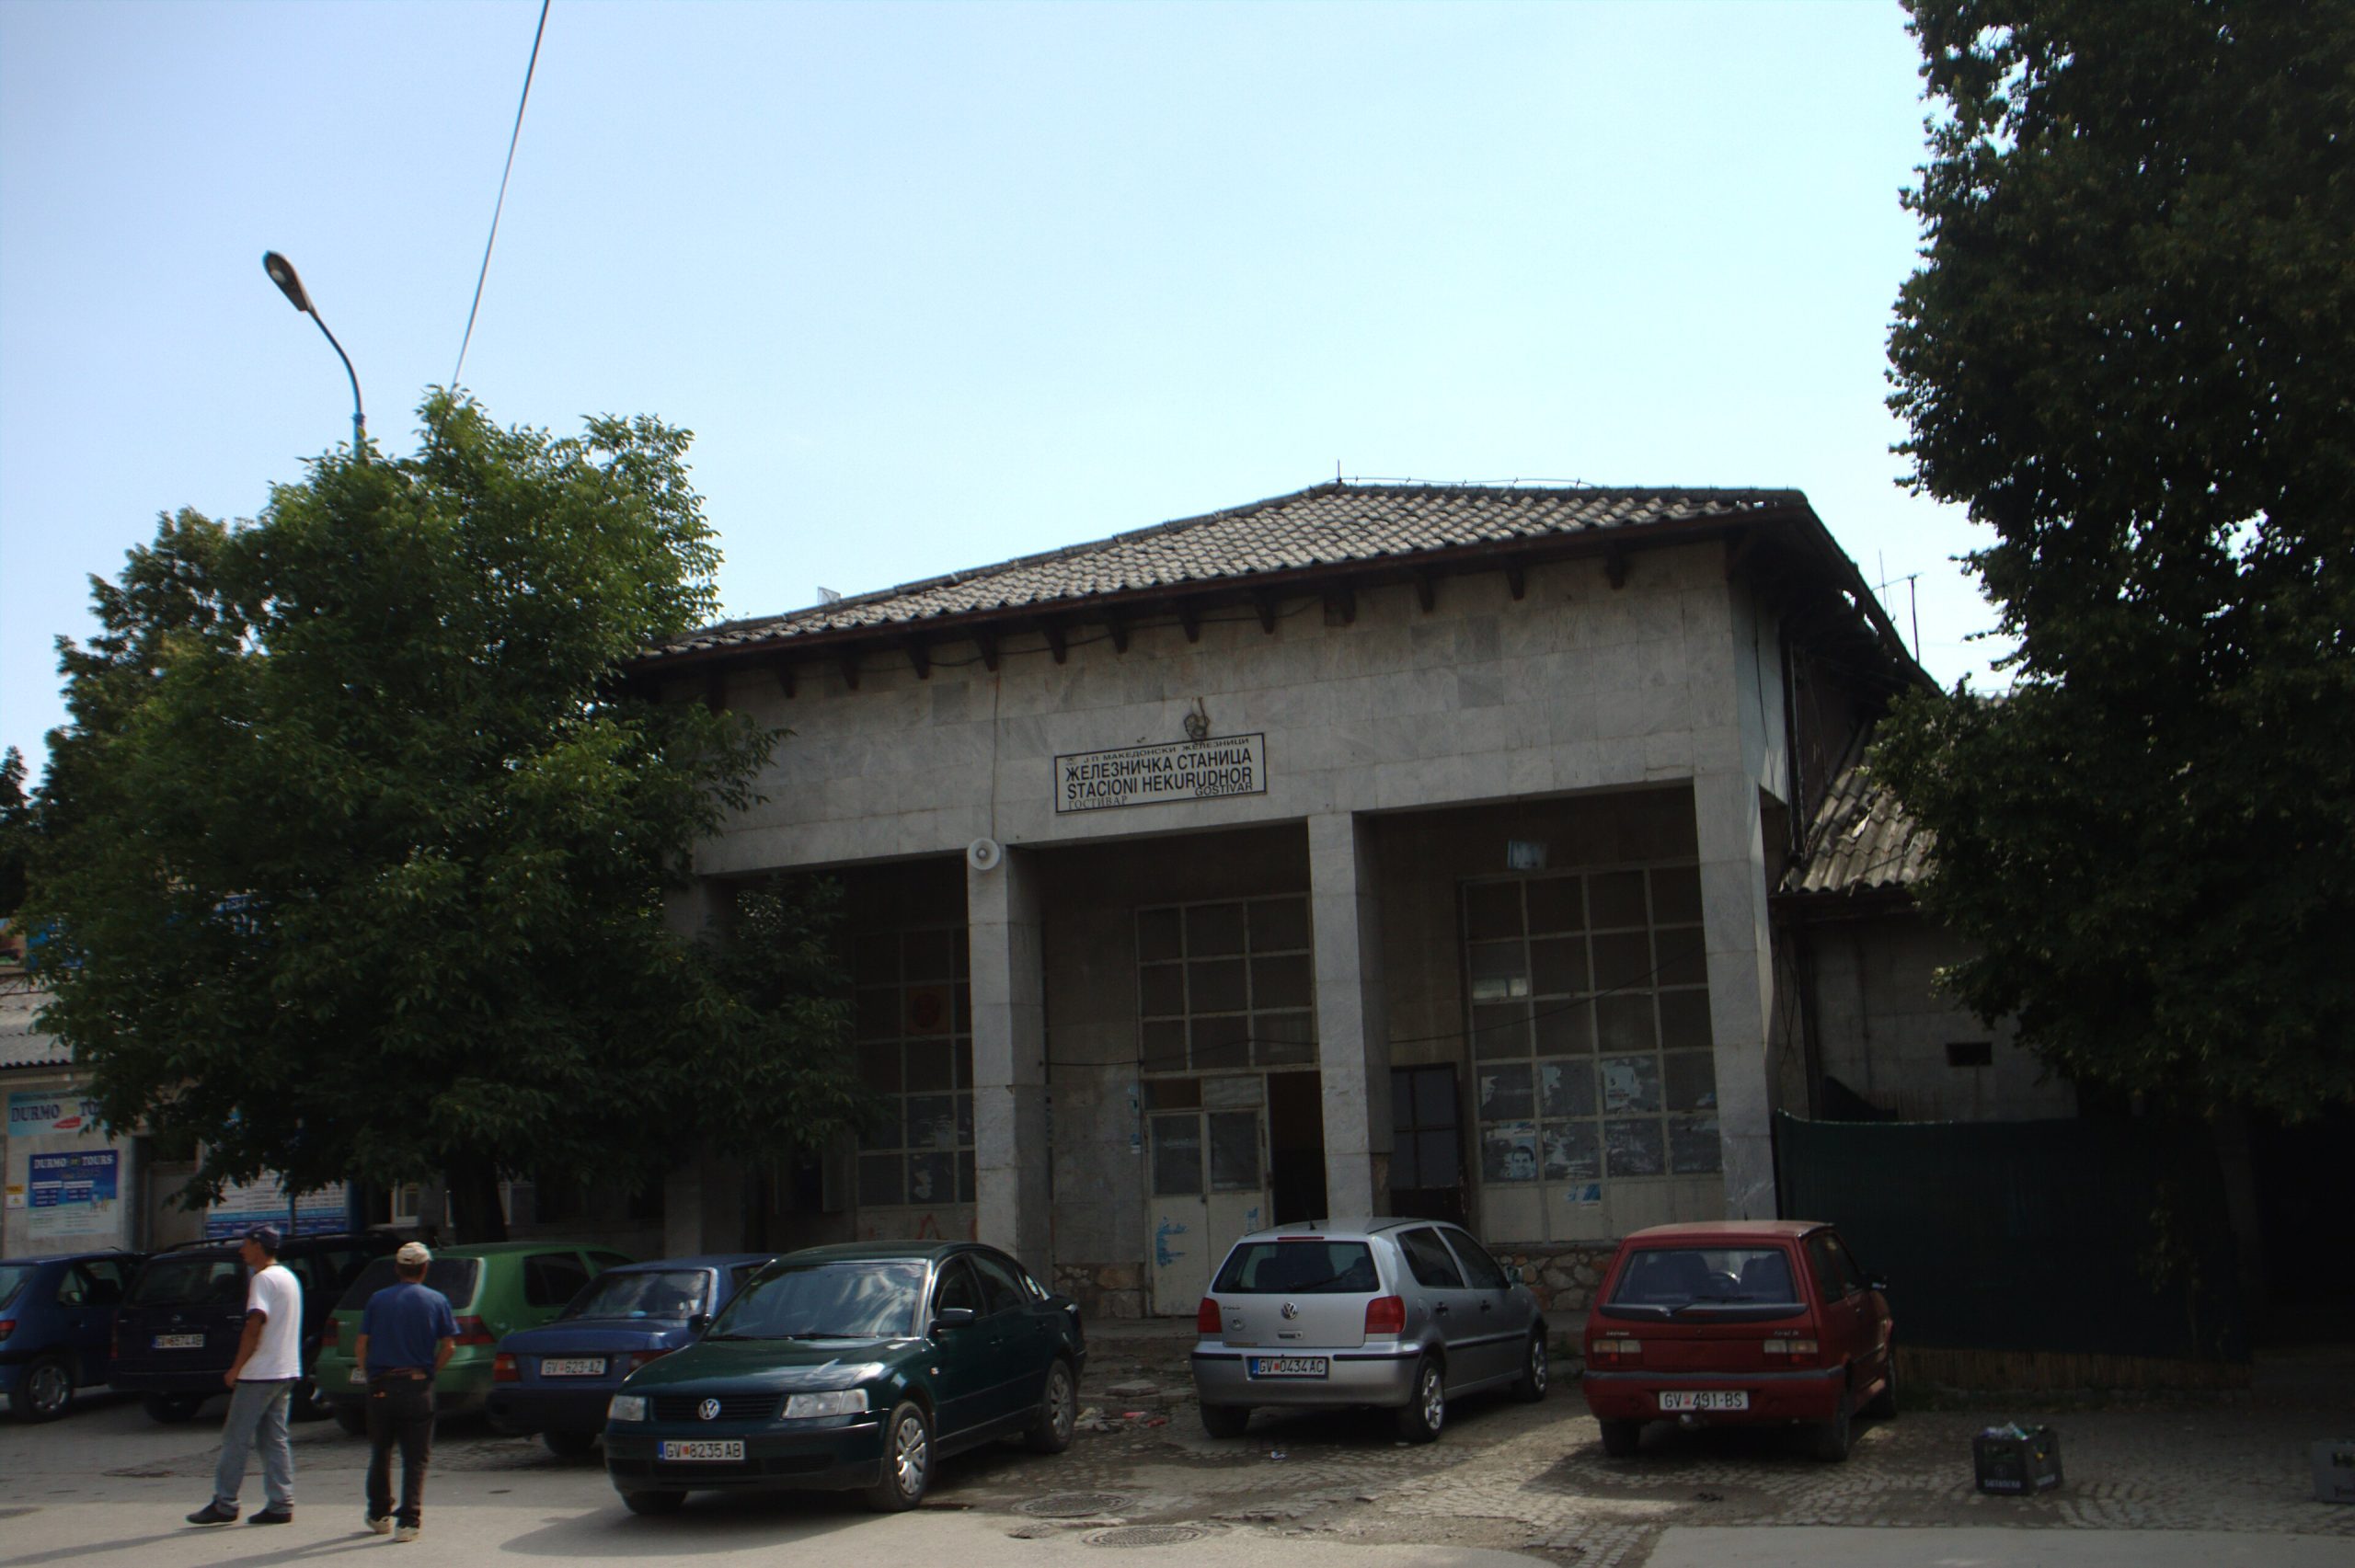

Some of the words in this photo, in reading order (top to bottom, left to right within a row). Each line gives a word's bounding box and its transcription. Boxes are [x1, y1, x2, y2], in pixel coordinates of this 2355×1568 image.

[1103, 747, 1177, 761] МАКЕДОНСКИ
[1182, 738, 1249, 751] ЖЕЛЕЗНИЦИ
[1065, 756, 1173, 782] ЖЕЛЕЗНИЧКА
[1178, 748, 1252, 770] СТАНИЦА
[1067, 777, 1137, 799] STACIONI
[1143, 767, 1252, 793] HEKURUDHOR
[1195, 782, 1252, 796] GOSTIVAR
[1068, 795, 1128, 810] ГОСТИВАР
[11, 1104, 60, 1122] DURMO
[34, 1158, 67, 1169] DURMO
[82, 1155, 113, 1166] TOURS
[1260, 1360, 1273, 1373] GV
[1281, 1360, 1307, 1373] 0434
[1310, 1360, 1324, 1373] AC
[1665, 1392, 1682, 1408] GV
[666, 1443, 681, 1458] GV
[690, 1443, 722, 1458] 8235
[726, 1443, 741, 1458] AB
